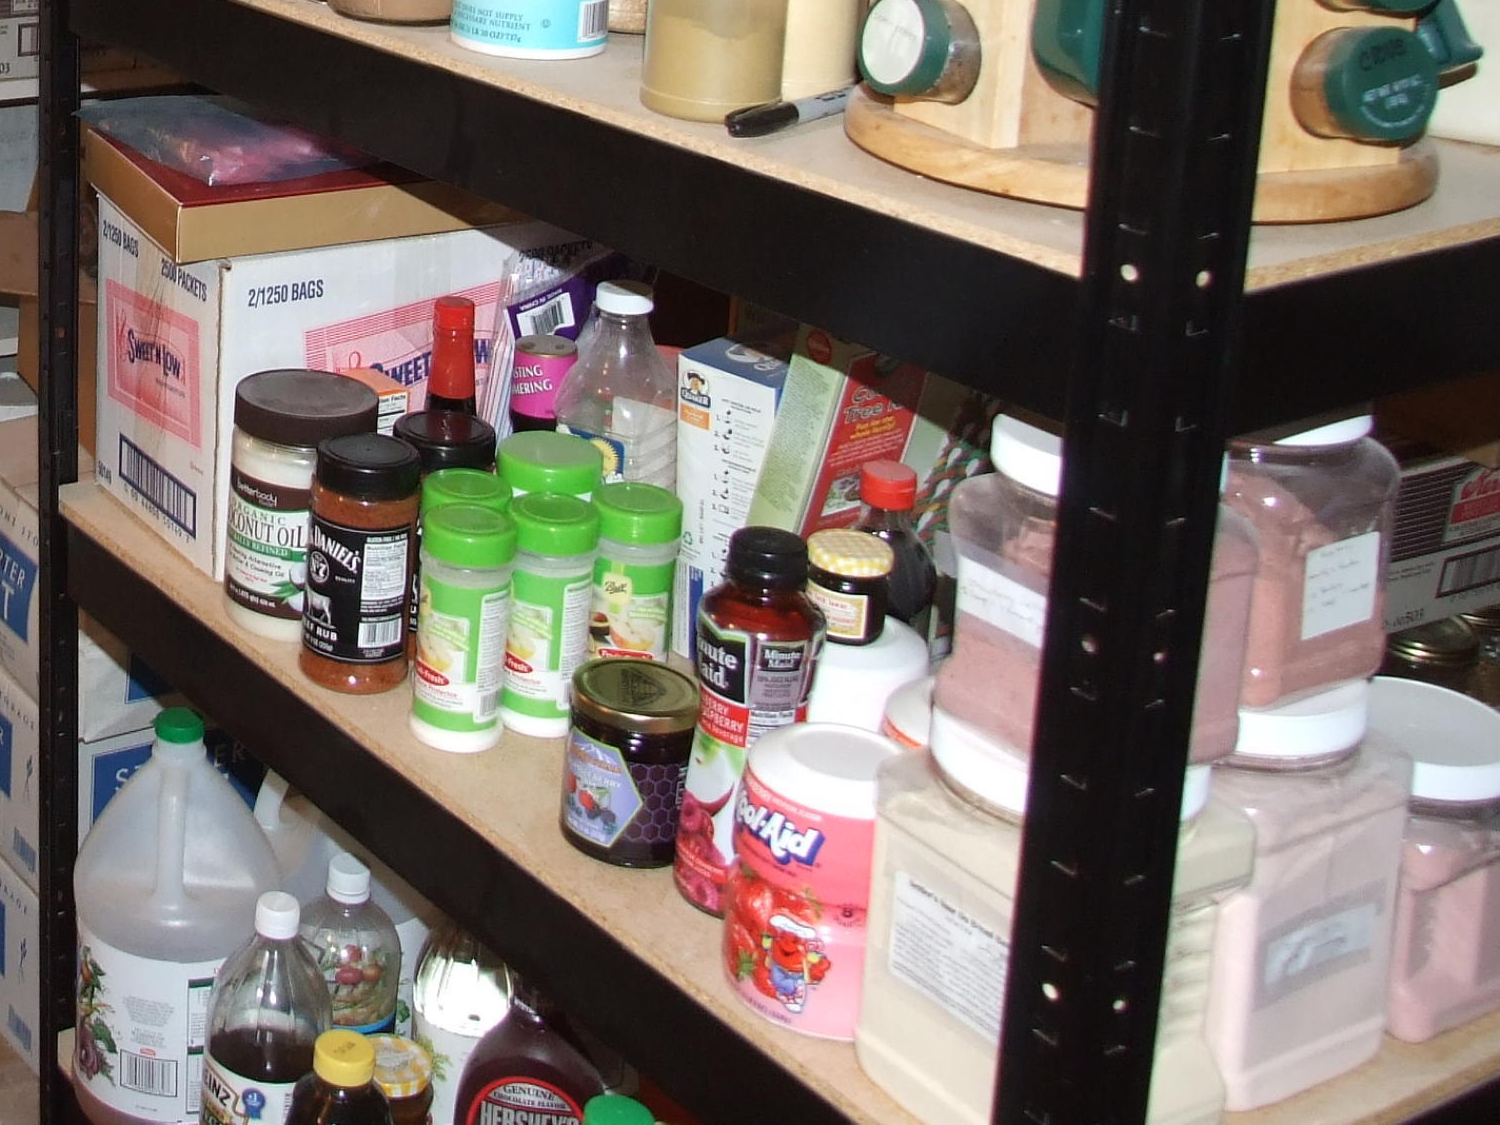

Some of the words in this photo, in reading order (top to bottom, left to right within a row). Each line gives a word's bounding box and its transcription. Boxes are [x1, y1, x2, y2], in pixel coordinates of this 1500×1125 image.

[488, 17, 530, 31] NUTRIENT
[495, 10, 524, 22] SUPPLY
[102, 220, 122, 249] 2/1250
[122, 235, 139, 258] BAGS
[177, 267, 207, 302] PACKETS
[248, 283, 289, 308] 2/1250
[291, 279, 324, 302] BAGS
[681, 388, 711, 407] QUAKER
[844, 403, 883, 423] Tree
[278, 526, 306, 548] OIL
[314, 525, 361, 573] DANIEL'S
[316, 627, 338, 641] RUB
[764, 648, 801, 661] Minute
[701, 663, 725, 688] aid
[503, 1085, 555, 1101] GENUINE
